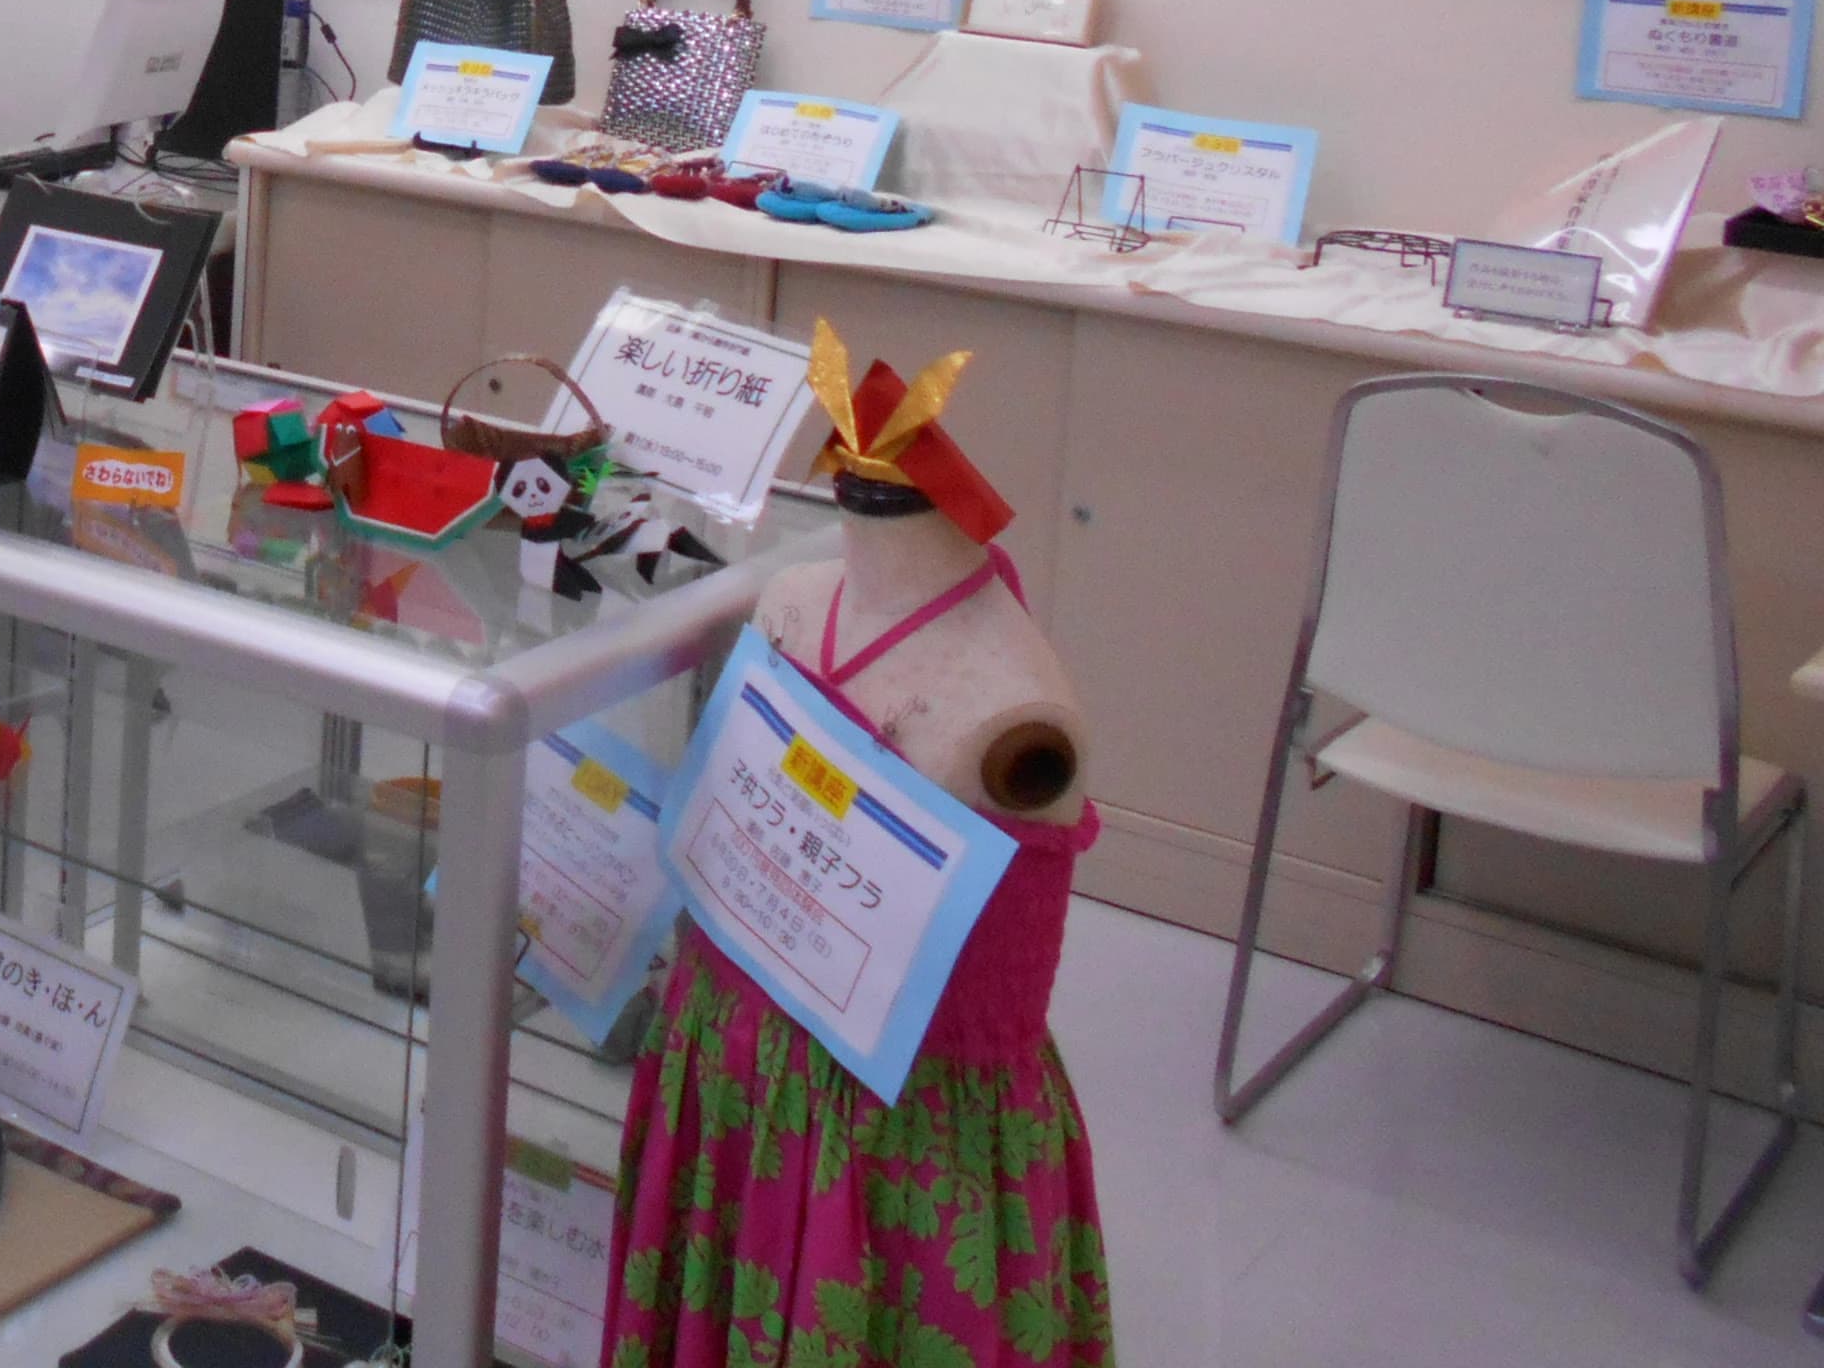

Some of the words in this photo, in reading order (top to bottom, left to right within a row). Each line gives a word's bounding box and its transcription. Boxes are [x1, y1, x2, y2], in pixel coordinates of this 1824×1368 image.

[614, 334, 773, 408] 楽しい折り紙
[729, 757, 884, 910] 子供フラ・親子フラ
